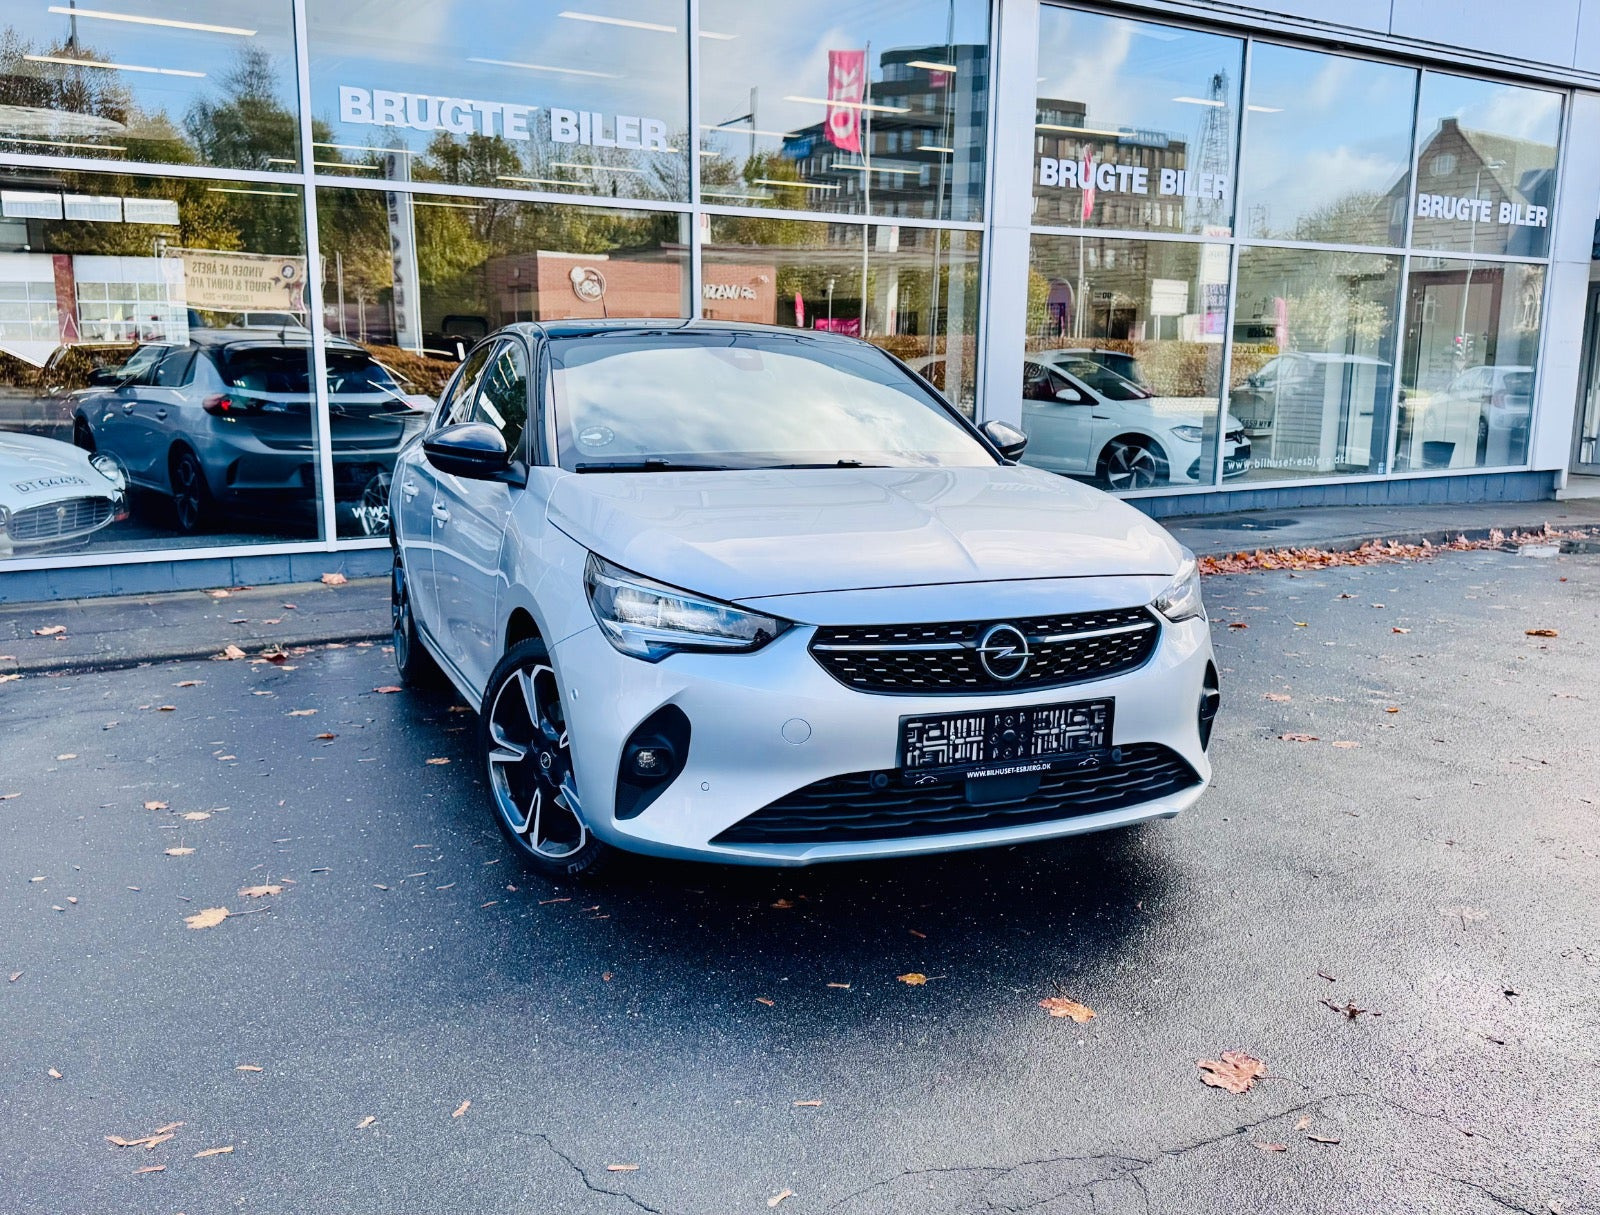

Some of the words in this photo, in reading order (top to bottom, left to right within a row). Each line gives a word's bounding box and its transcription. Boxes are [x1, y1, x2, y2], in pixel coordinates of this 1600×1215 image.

[339, 85, 533, 141] BRUGTE
[551, 107, 668, 153] BILER
[1039, 157, 1148, 195] BRUGTE
[1160, 167, 1230, 200] BILER
[1417, 193, 1493, 223] BRUGTE
[1498, 201, 1549, 228] BILER
[966, 763, 1051, 779] WWW.BILHUSET-ESBJERG.DK
